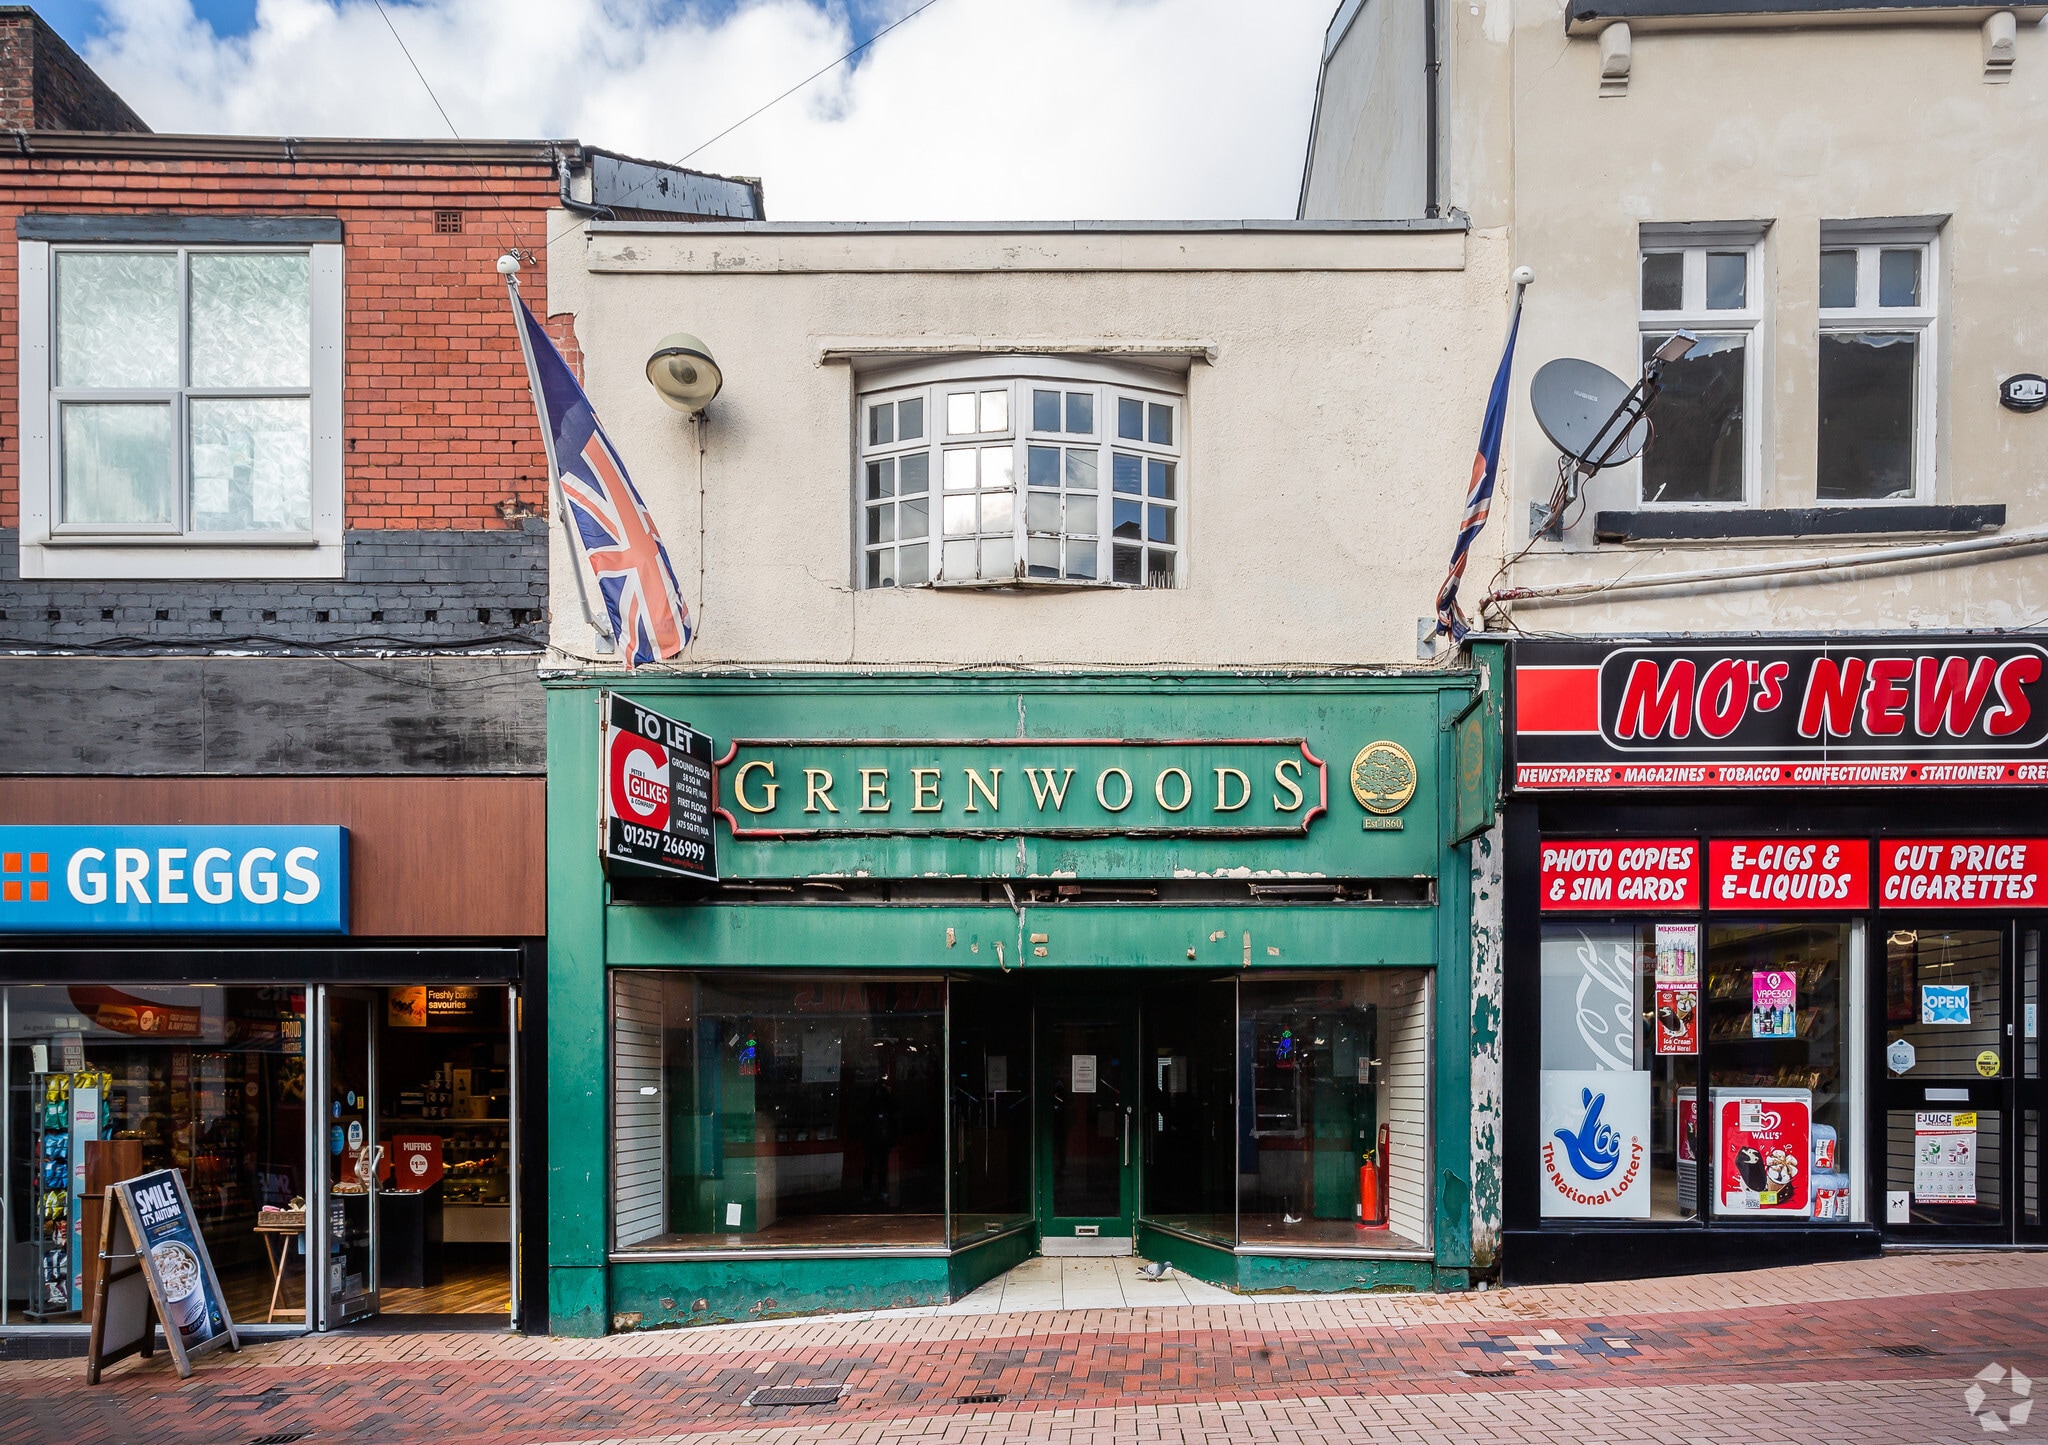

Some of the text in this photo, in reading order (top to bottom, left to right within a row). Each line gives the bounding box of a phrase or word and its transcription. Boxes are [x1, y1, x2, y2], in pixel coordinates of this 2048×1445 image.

[1797, 655, 2043, 738] NEWS
[634, 708, 693, 754] TO LET
[630, 767, 643, 777] PETER
[672, 757, 711, 780] GROUND FLOOR
[1518, 765, 2048, 784] NEWSPAPERS MAGAZINES TOBACCO CONFECTIONERY STATIONERY GRE
[682, 773, 689, 781] 58
[689, 775, 696, 784] SQ
[734, 759, 1304, 813] GREENWOODS
[631, 777, 668, 804] GILKES
[685, 785, 692, 795] SQ
[635, 799, 655, 809] COMPANY
[677, 797, 707, 814] FIRST FLOOR
[676, 820, 687, 829] (475
[686, 822, 694, 832] SQ
[683, 811, 690, 819] 44
[690, 813, 697, 822] SQ
[1382, 818, 1402, 828] 1860
[623, 824, 705, 861] 01257 266999
[1542, 847, 1694, 872] PHOTO COPIES
[1731, 845, 1840, 871] E-CIGS &
[1894, 845, 2027, 872] CUT PRICE
[66, 846, 322, 905] GREGGS
[1549, 876, 1688, 901] & SIM CARDS
[1721, 873, 1852, 901] E-LIQUIDS
[1884, 874, 2037, 901] CIGARETTES
[1658, 926, 1696, 934] MILKSHAKER
[428, 990, 478, 1001] Freshly baked
[1756, 989, 1792, 998] VAPE360
[1926, 996, 1965, 1009] OPEN
[428, 1000, 467, 1009] savouries
[281, 1021, 302, 1038] PROUD
[1752, 1132, 1780, 1140] WALL'S
[403, 1142, 432, 1151] MUFFINS
[1542, 1141, 1556, 1173] The
[1550, 1172, 1612, 1205] National
[135, 1181, 178, 1215] SMILE
[142, 1204, 181, 1226] IT'S AUTUMN
